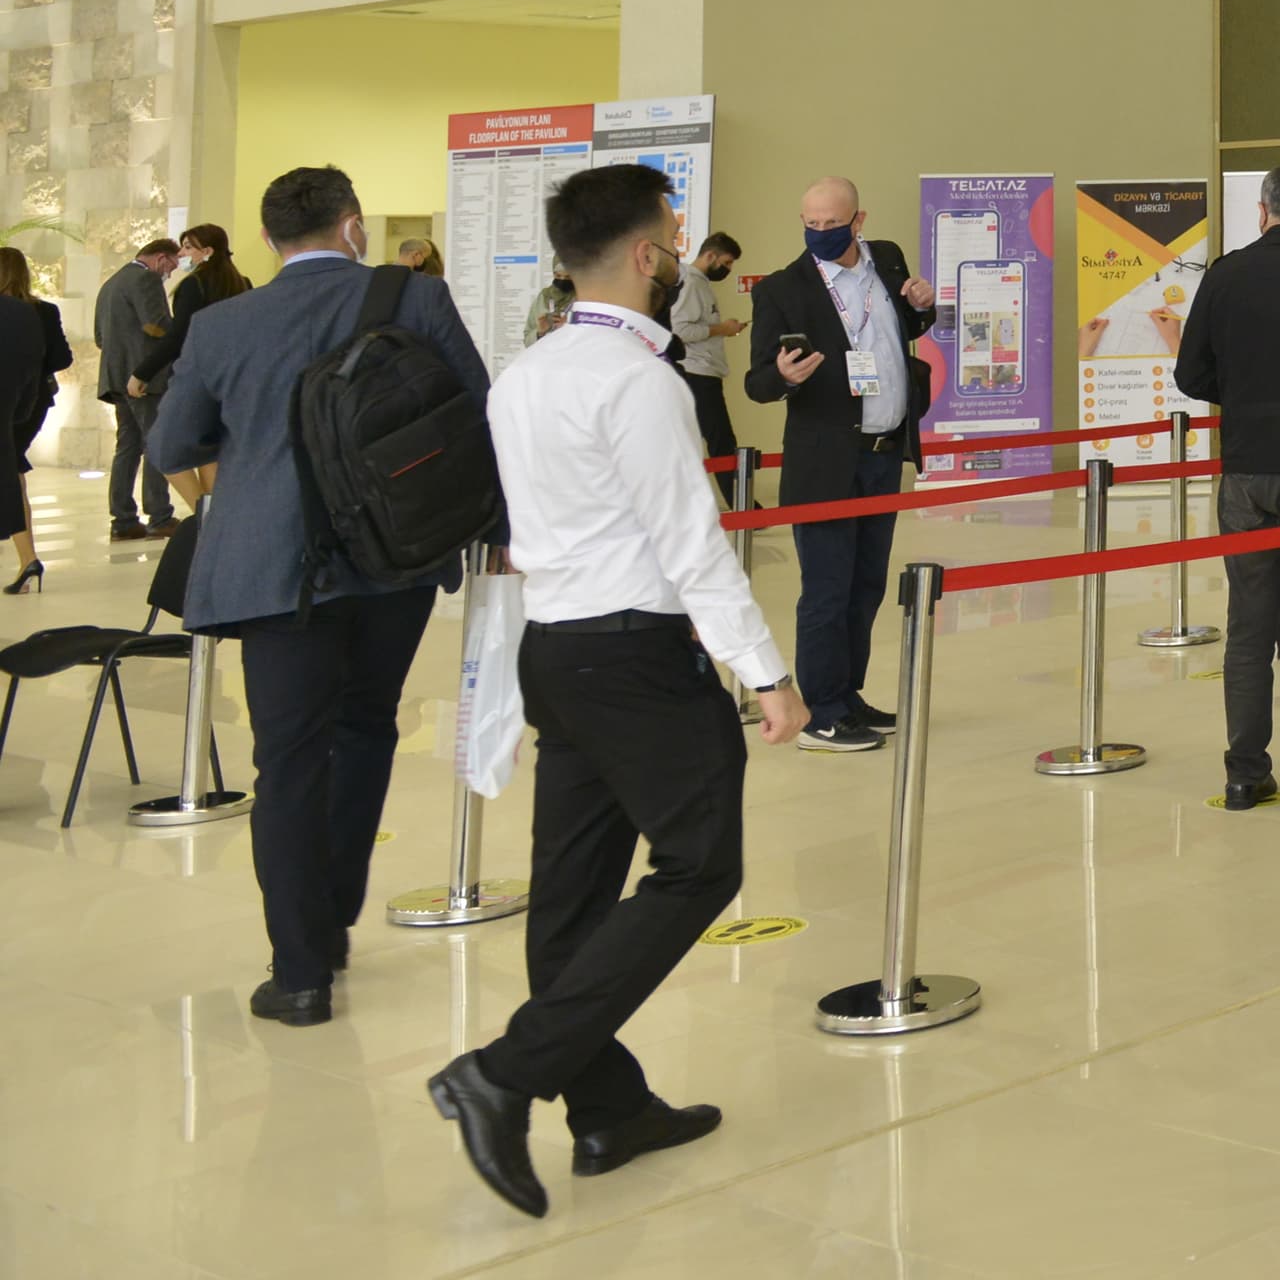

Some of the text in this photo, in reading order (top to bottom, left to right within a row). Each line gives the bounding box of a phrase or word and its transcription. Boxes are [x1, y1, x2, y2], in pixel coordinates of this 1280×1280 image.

[469, 127, 568, 144] FLOORPLAN OF THE PAVILION
[948, 180, 1027, 192] TELSAT.AZ
[1114, 192, 1147, 201] DİZAYN
